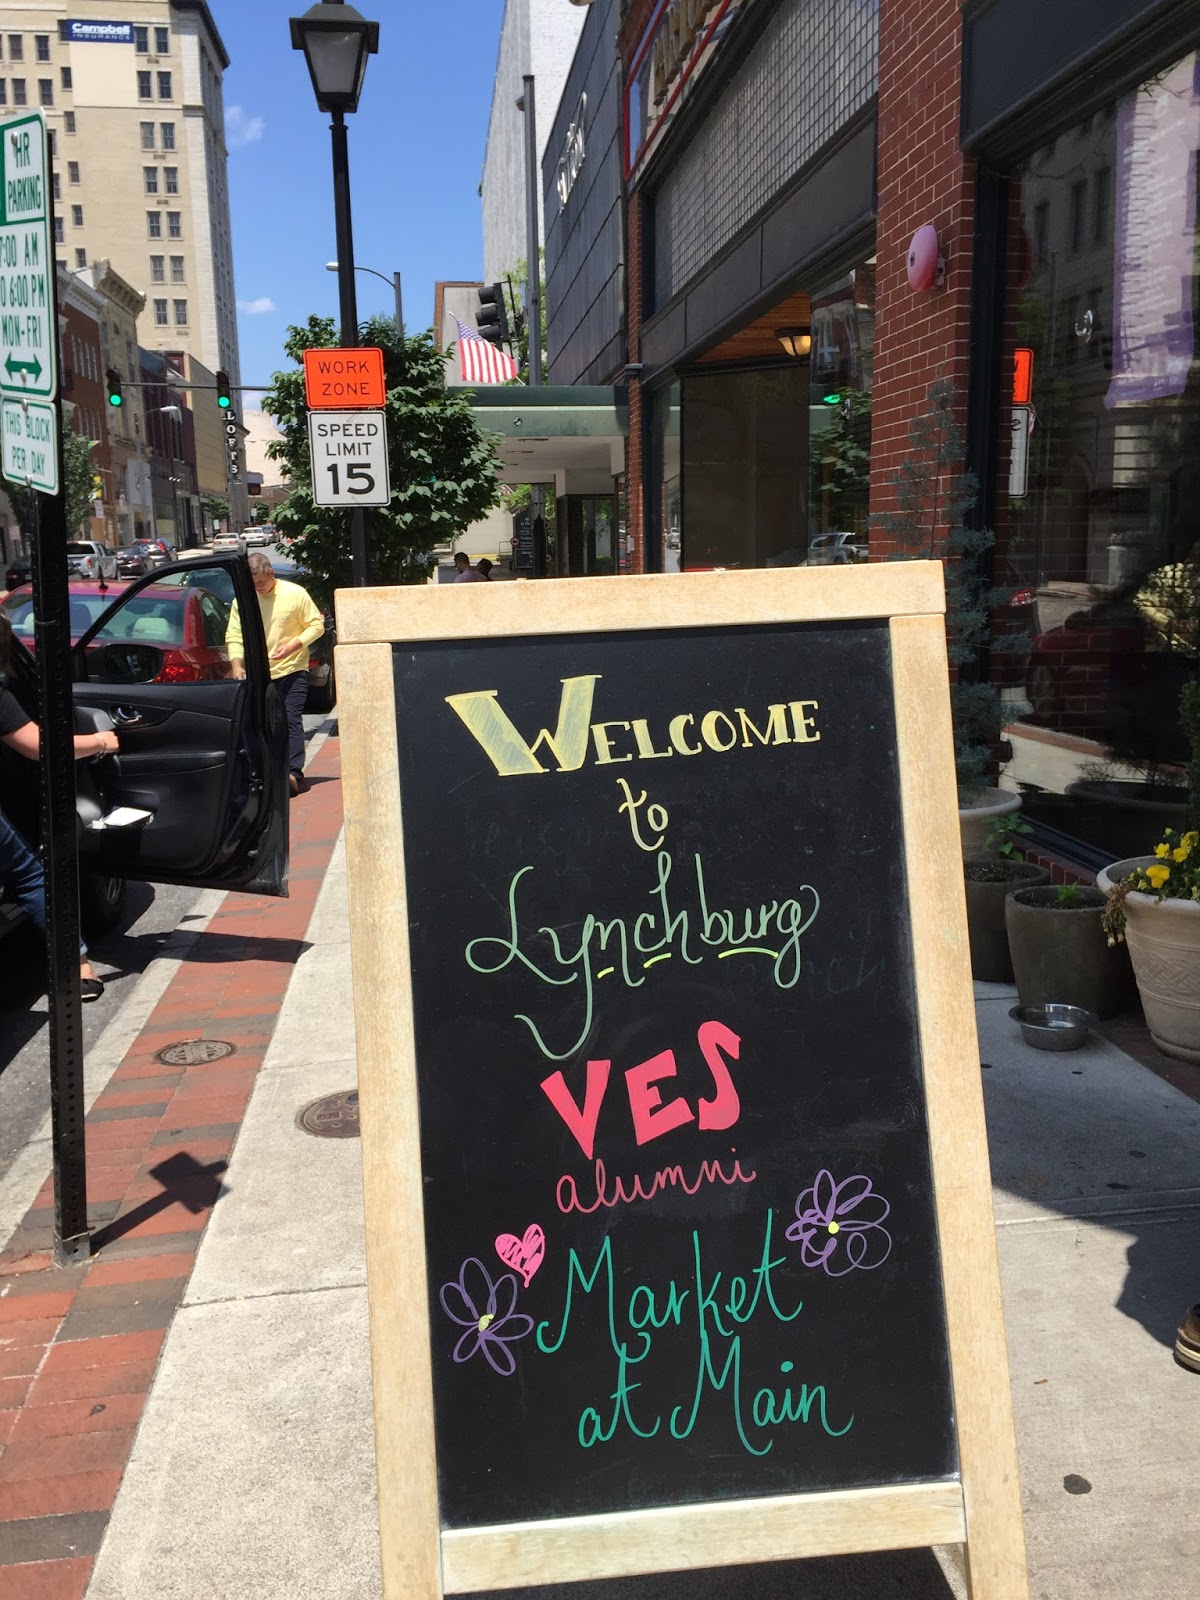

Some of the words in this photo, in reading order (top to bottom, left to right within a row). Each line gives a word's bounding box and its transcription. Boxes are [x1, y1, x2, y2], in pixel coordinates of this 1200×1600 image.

[72, 23, 131, 35] Campbell
[14, 131, 31, 168] HR
[8, 175, 42, 214] PARKING
[25, 232, 39, 266] AM
[10, 275, 28, 308] 6:00
[31, 274, 45, 307] PM
[2, 315, 42, 348] MON-FRI
[318, 360, 370, 374] WORK
[321, 382, 371, 396] ZONE
[5, 411, 21, 436] THIS
[26, 415, 51, 443] BLOCK
[317, 423, 378, 437] SPEED
[12, 446, 26, 471] PER
[31, 451, 45, 476] DAY
[326, 442, 372, 456] LIMIT
[327, 463, 376, 495] 15
[615, 777, 669, 852] to
[465, 851, 820, 1060] Lynchburg
[540, 1020, 741, 1160] VES
[556, 1147, 756, 1213] alumni
[537, 1208, 802, 1363] Market
[578, 1342, 660, 1448] at
[669, 1331, 854, 1456] Main
